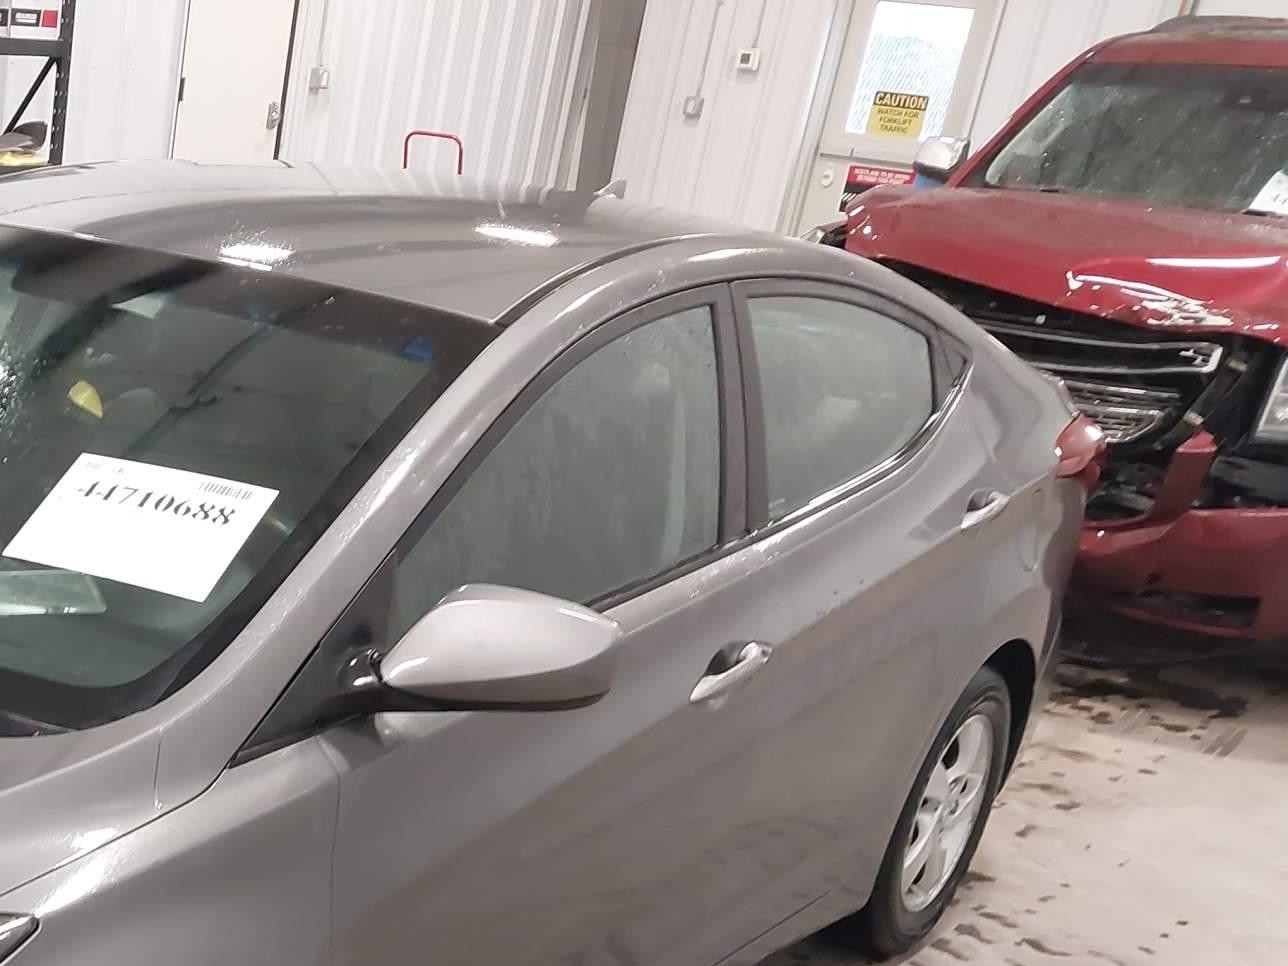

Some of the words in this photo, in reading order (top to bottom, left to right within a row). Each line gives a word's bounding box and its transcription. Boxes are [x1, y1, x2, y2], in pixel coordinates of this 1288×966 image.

[875, 92, 928, 110] CAUTION
[877, 107, 903, 117] WATCH
[904, 110, 920, 119] FOR
[879, 116, 913, 126] FORKLIFT
[880, 123, 909, 134] TRAFFIC
[77, 481, 236, 525] 44710688
